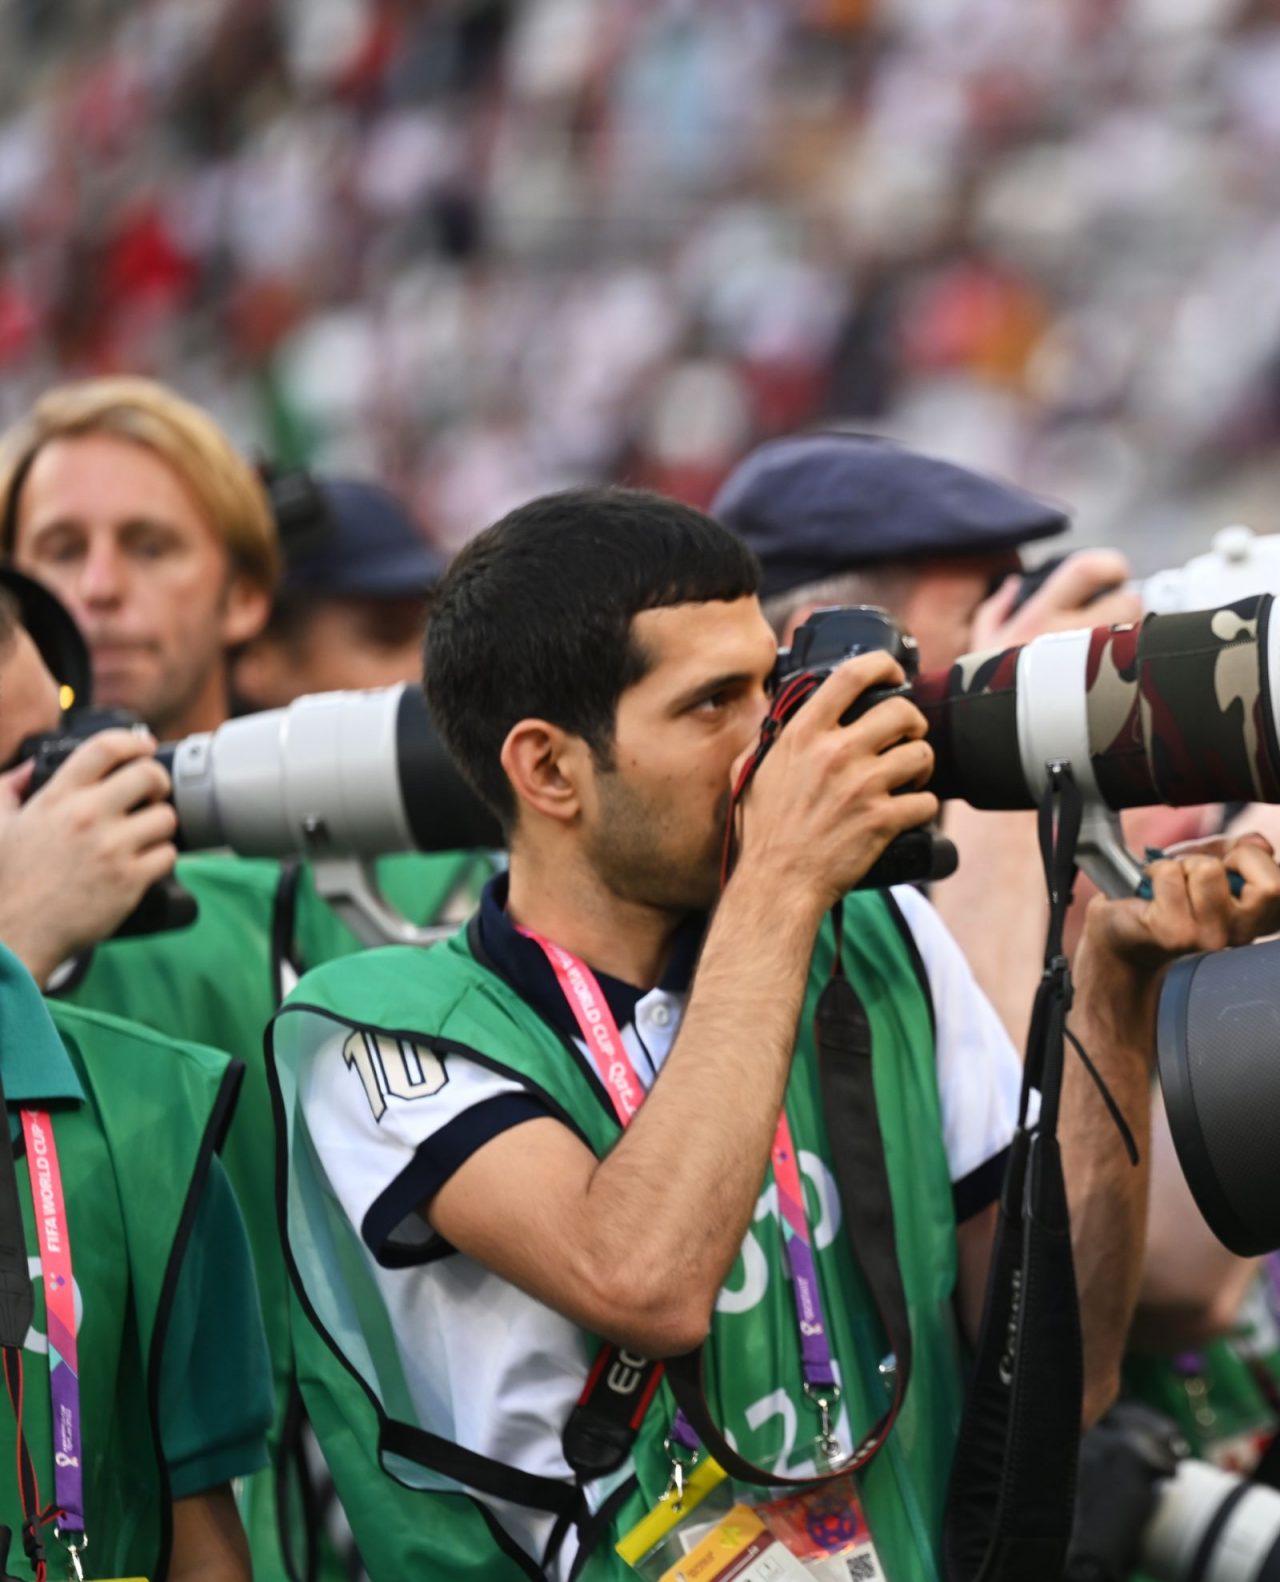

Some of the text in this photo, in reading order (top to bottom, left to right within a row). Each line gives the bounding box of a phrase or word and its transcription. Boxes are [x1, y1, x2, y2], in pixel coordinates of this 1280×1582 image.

[567, 967, 601, 1024] WORLD
[592, 1023, 615, 1057] CUP
[342, 1030, 449, 1124] 10
[31, 1123, 60, 1252] FIFA WORLD CUP
